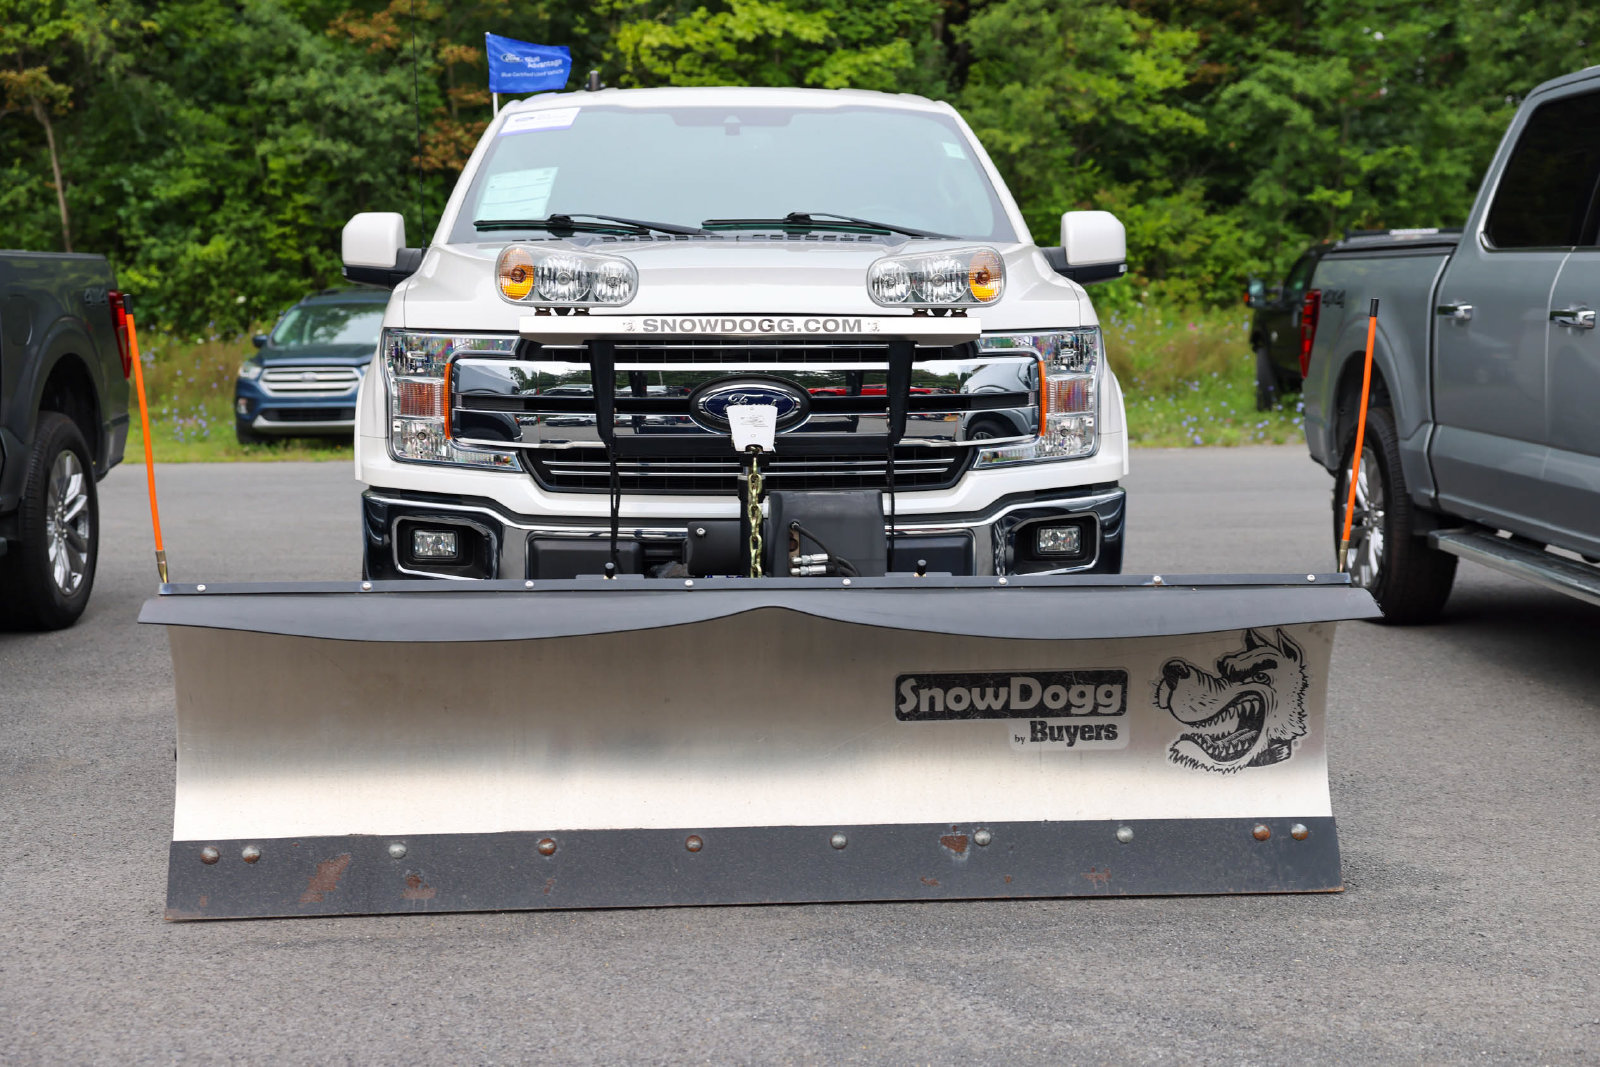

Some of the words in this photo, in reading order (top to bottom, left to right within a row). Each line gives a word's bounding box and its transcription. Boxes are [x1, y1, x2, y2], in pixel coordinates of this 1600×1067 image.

[642, 318, 862, 333] SNOWDOGG.COM
[898, 676, 1122, 714] SnowDogg
[1015, 734, 1026, 745] by
[1029, 720, 1118, 747] Buyers
